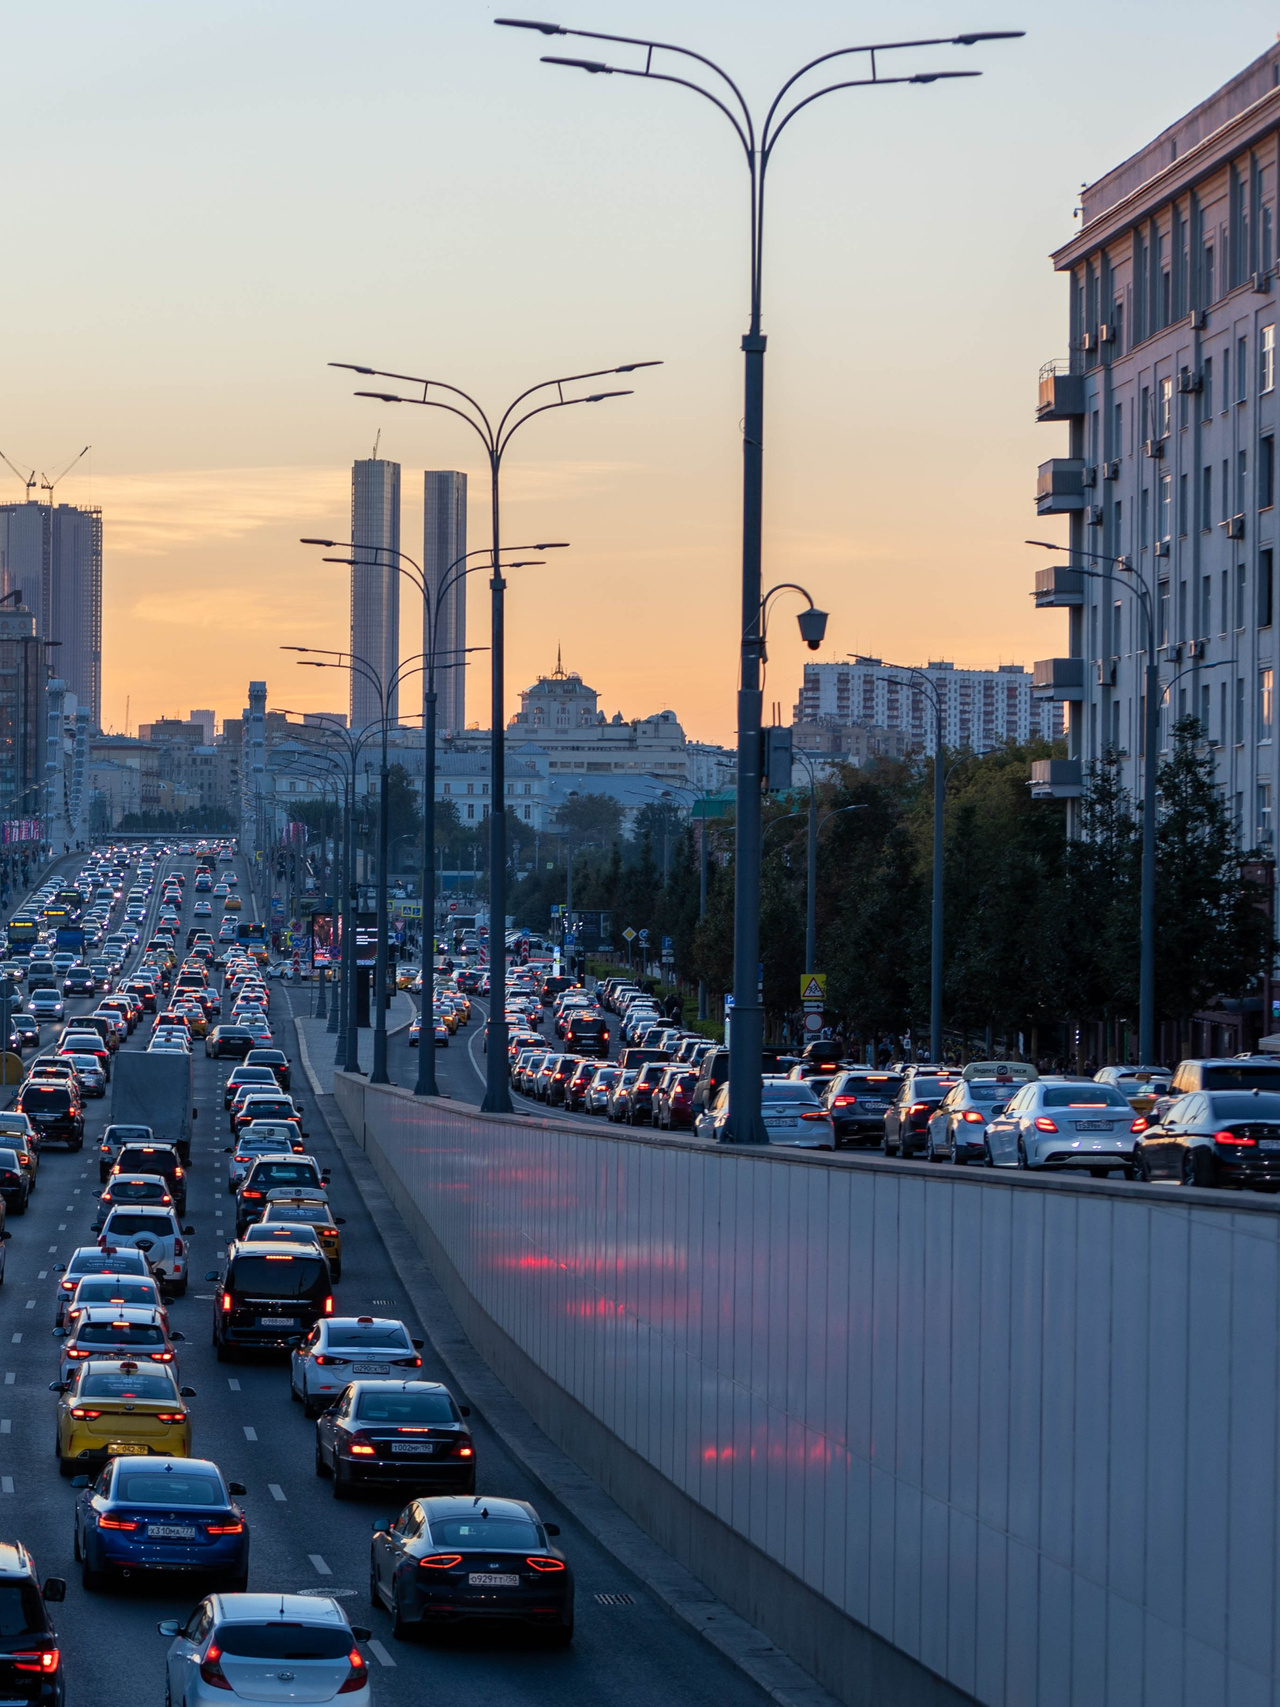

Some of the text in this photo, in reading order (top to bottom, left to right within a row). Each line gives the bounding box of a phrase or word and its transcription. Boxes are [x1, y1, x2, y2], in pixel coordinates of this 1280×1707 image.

[972, 1066, 1027, 1074] Яндекс Go Такси
